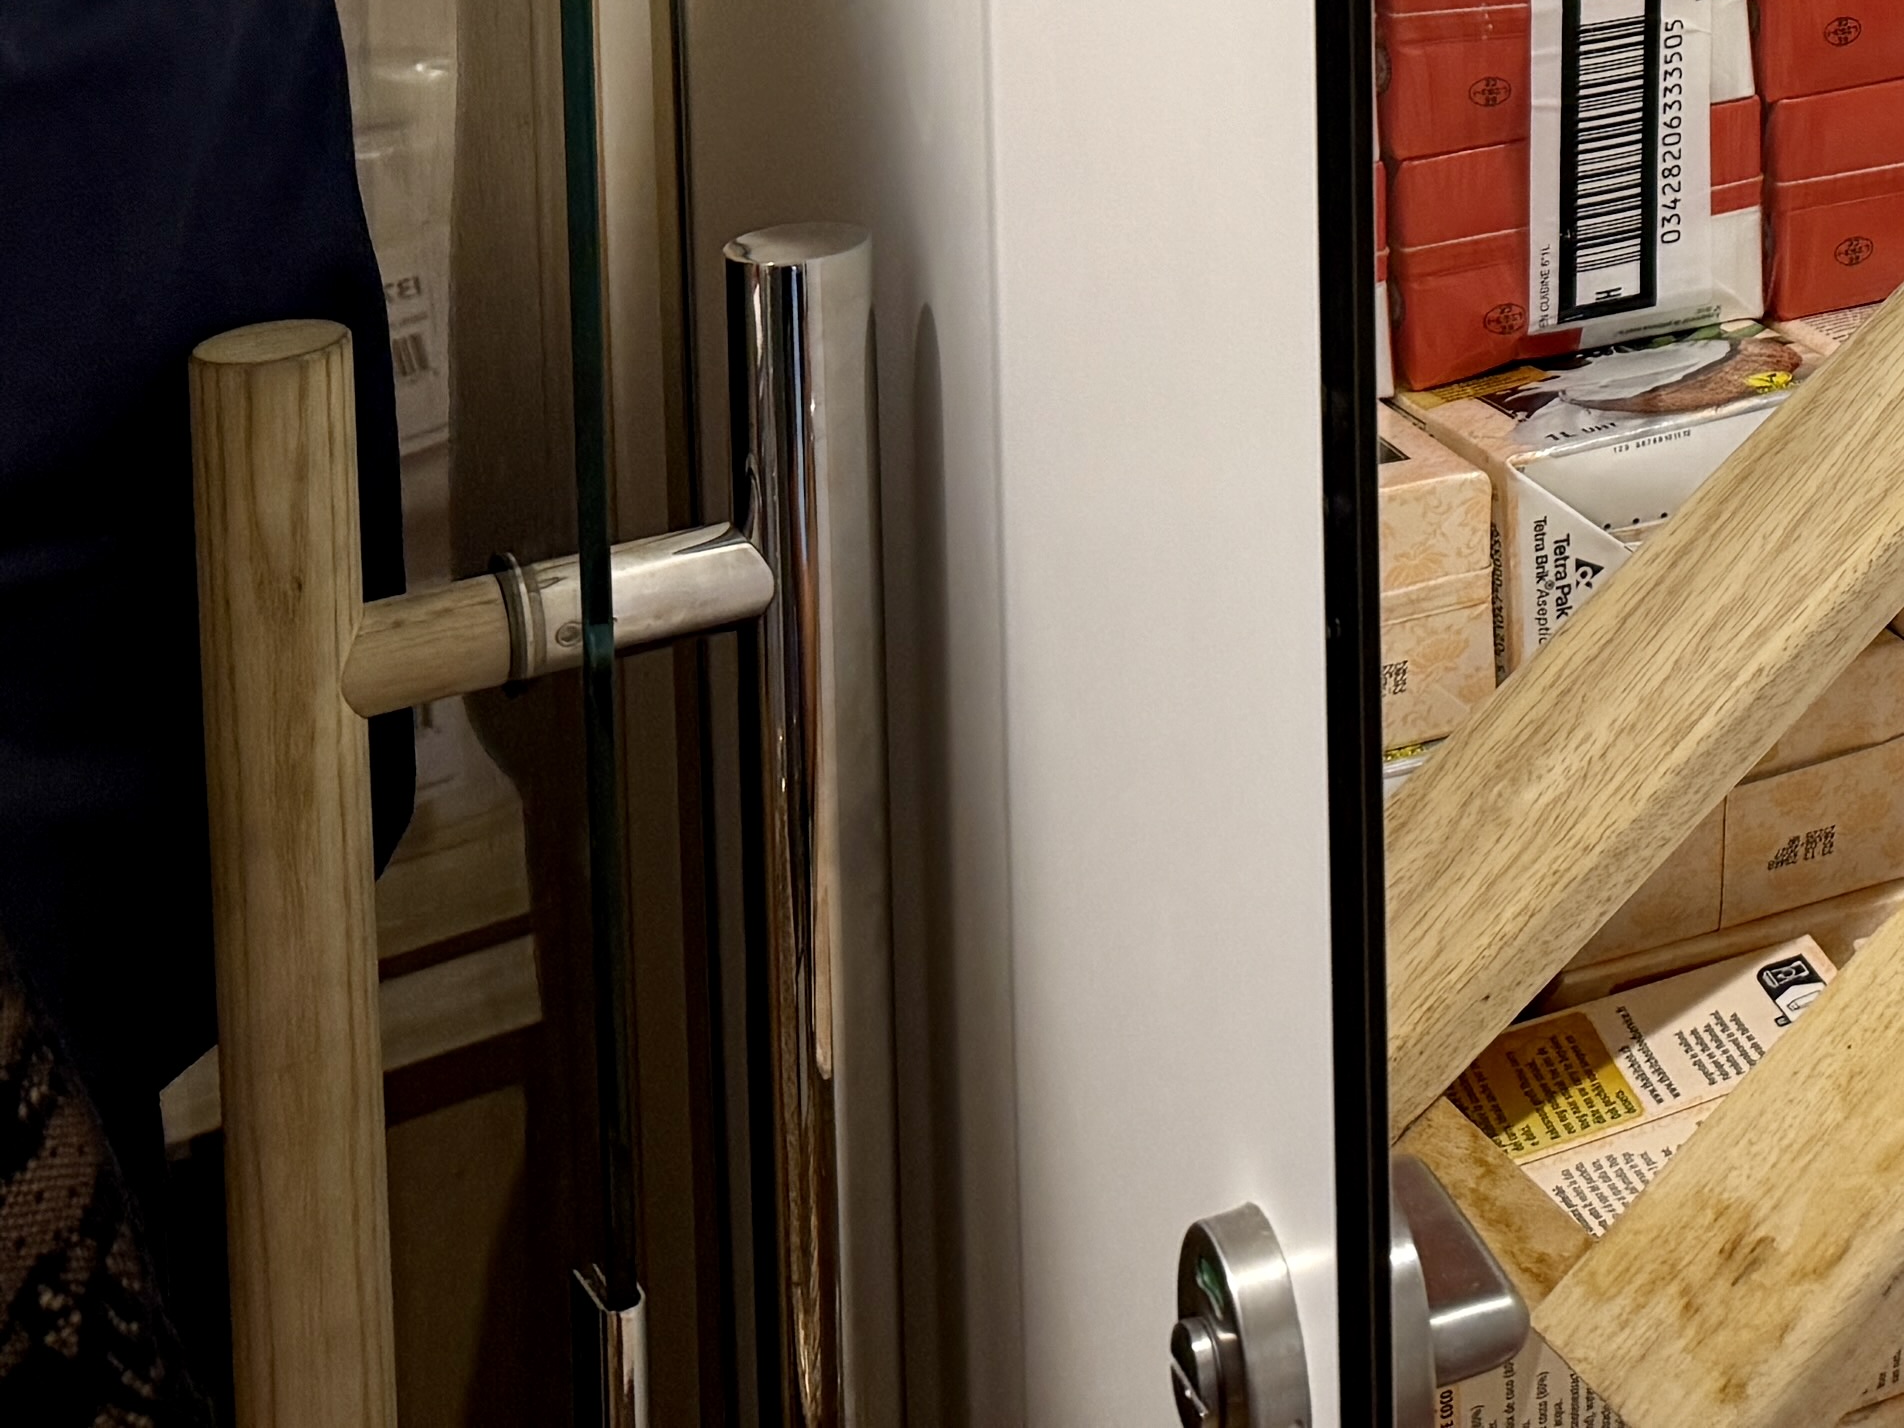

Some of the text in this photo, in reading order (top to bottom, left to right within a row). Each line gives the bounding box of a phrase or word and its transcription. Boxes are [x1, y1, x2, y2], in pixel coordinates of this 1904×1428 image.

[1659, 18, 1684, 244] 03428206333505
[1533, 515, 1547, 552] Tetra
[1553, 533, 1572, 619] Tetra Pak
